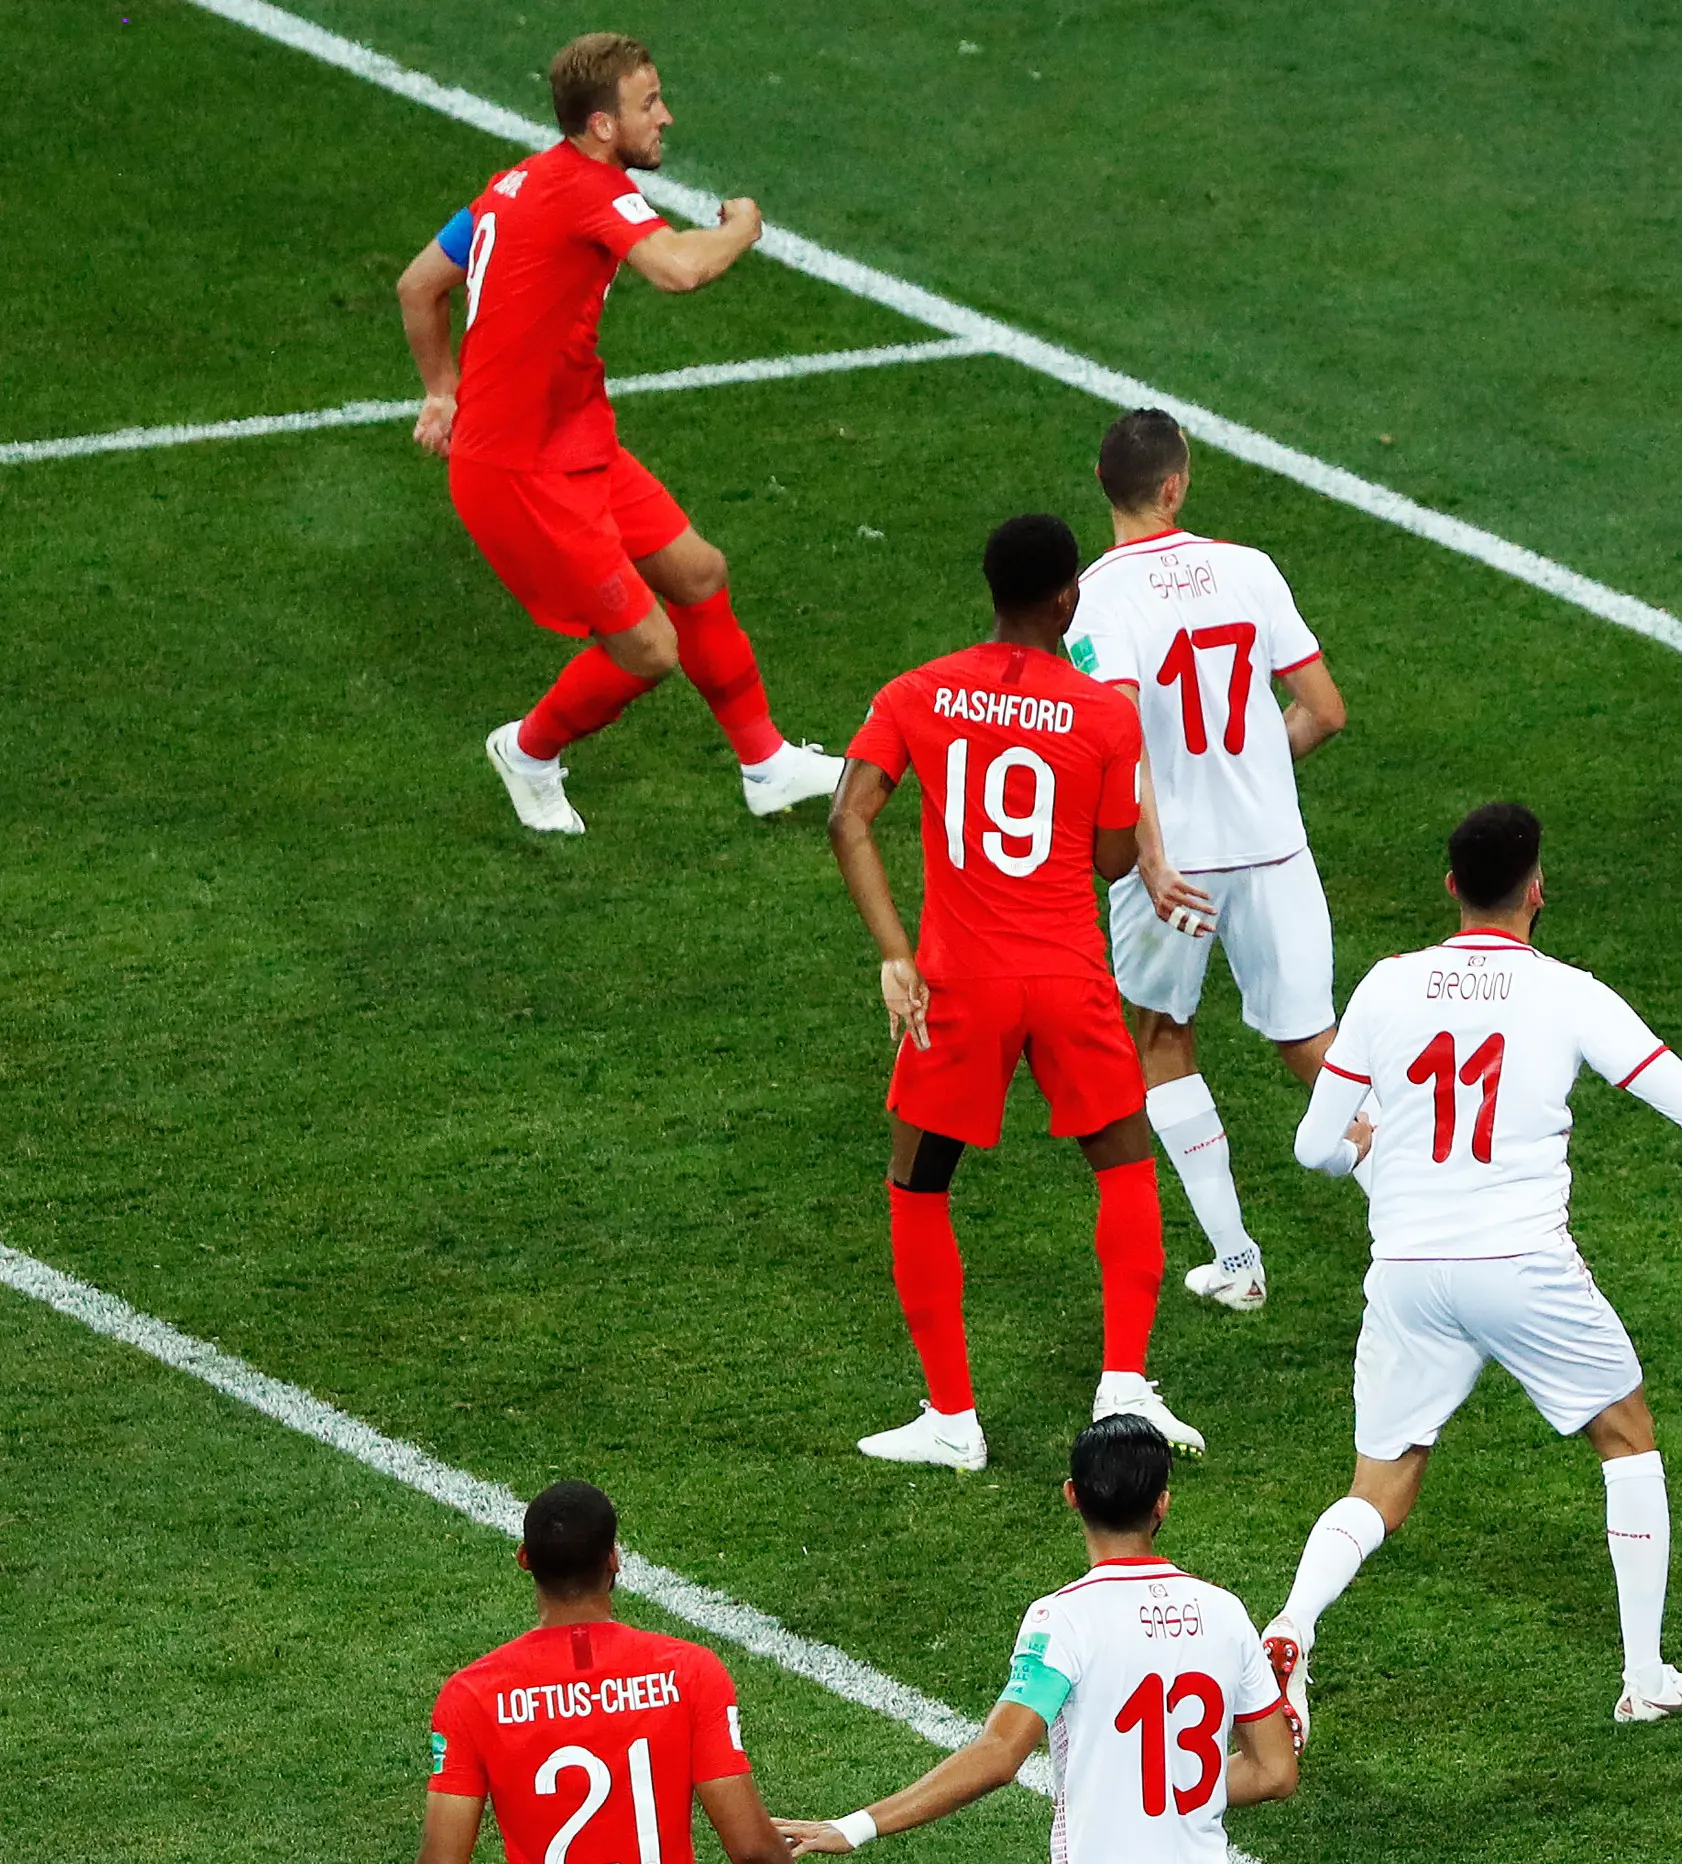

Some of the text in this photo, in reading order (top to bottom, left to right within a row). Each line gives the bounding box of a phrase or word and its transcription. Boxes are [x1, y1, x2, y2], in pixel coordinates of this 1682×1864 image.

[933, 687, 1074, 733] RASHFORD
[1156, 621, 1257, 755] 17
[944, 738, 1056, 878] 19
[1426, 970, 1513, 1001] BRONN
[1406, 1030, 1506, 1164] 11
[1139, 1598, 1204, 1639] SASSI
[497, 1670, 680, 1724] LOFTUS-CHEEK
[1114, 1671, 1225, 1817] 13
[534, 1737, 661, 1864] 21
